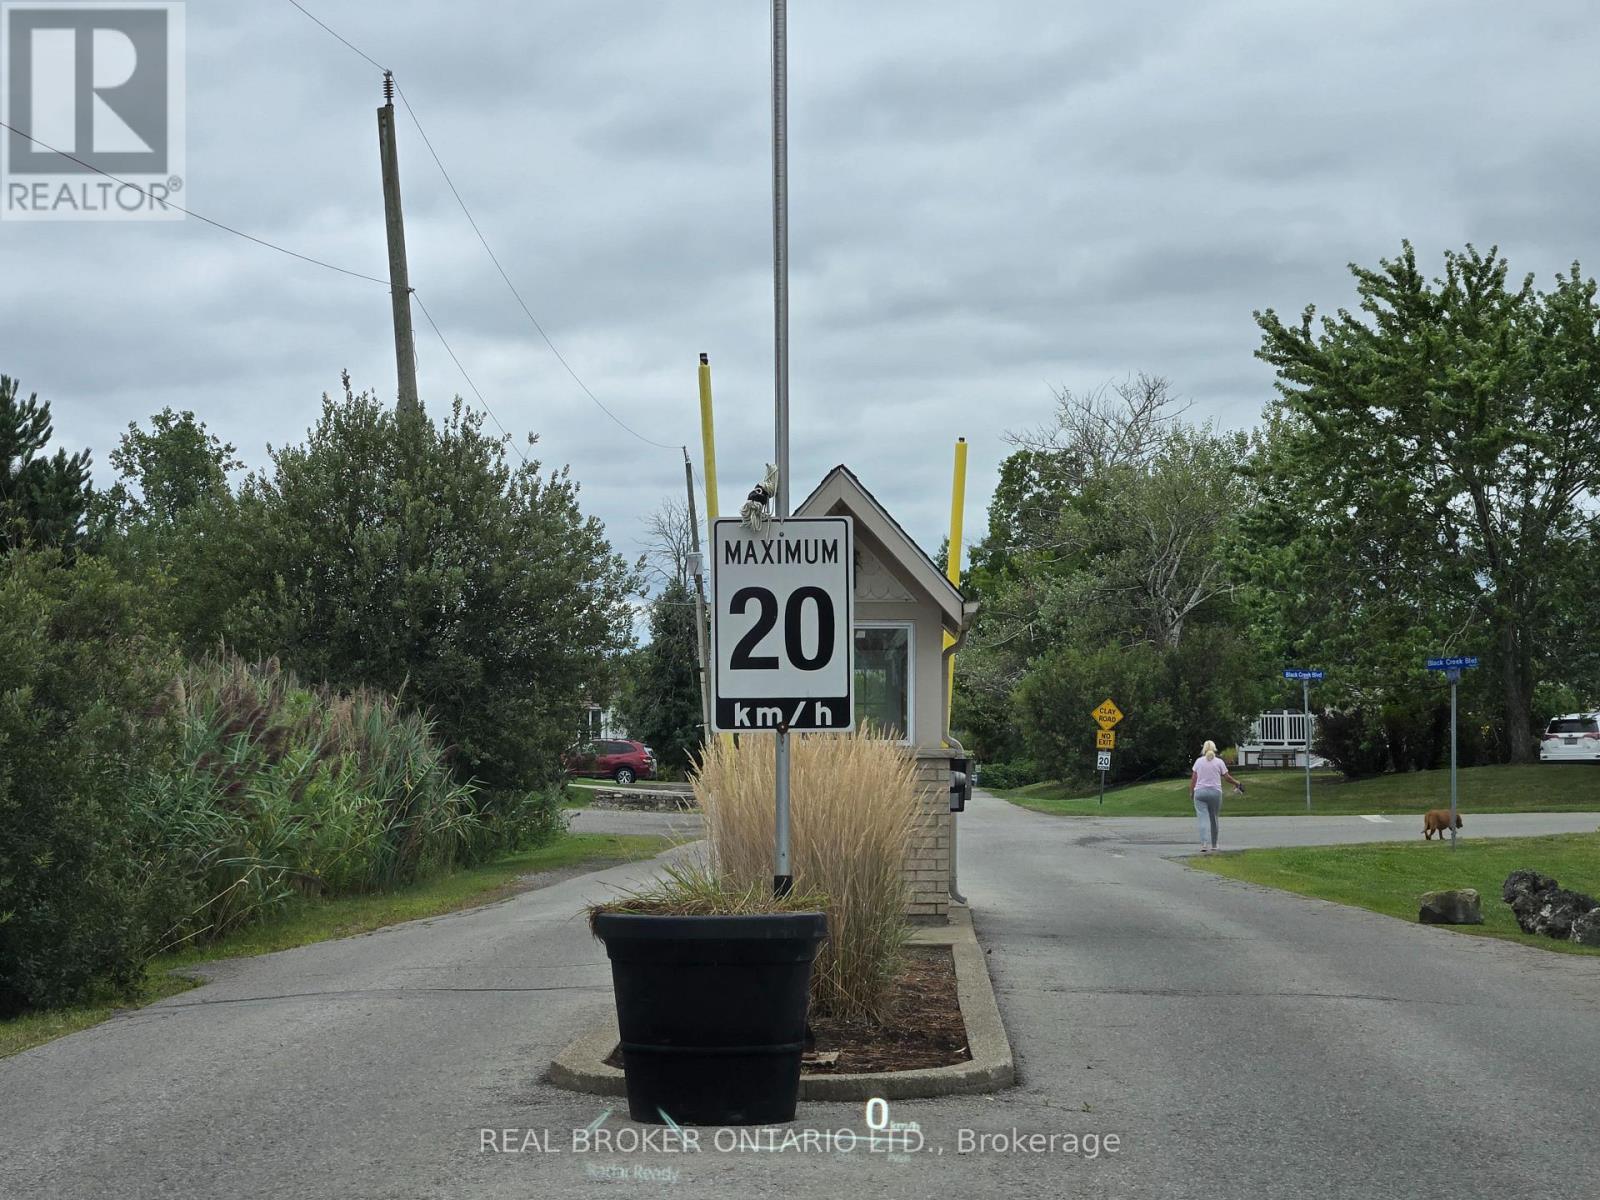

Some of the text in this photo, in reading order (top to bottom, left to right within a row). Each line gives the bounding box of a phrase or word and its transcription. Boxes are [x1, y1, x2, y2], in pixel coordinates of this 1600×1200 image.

[724, 539, 838, 565] MAXIMUM
[729, 586, 835, 671] 20
[734, 701, 832, 727] km/h
[1099, 757, 1109, 766] 20
[866, 1097, 889, 1130] 0
